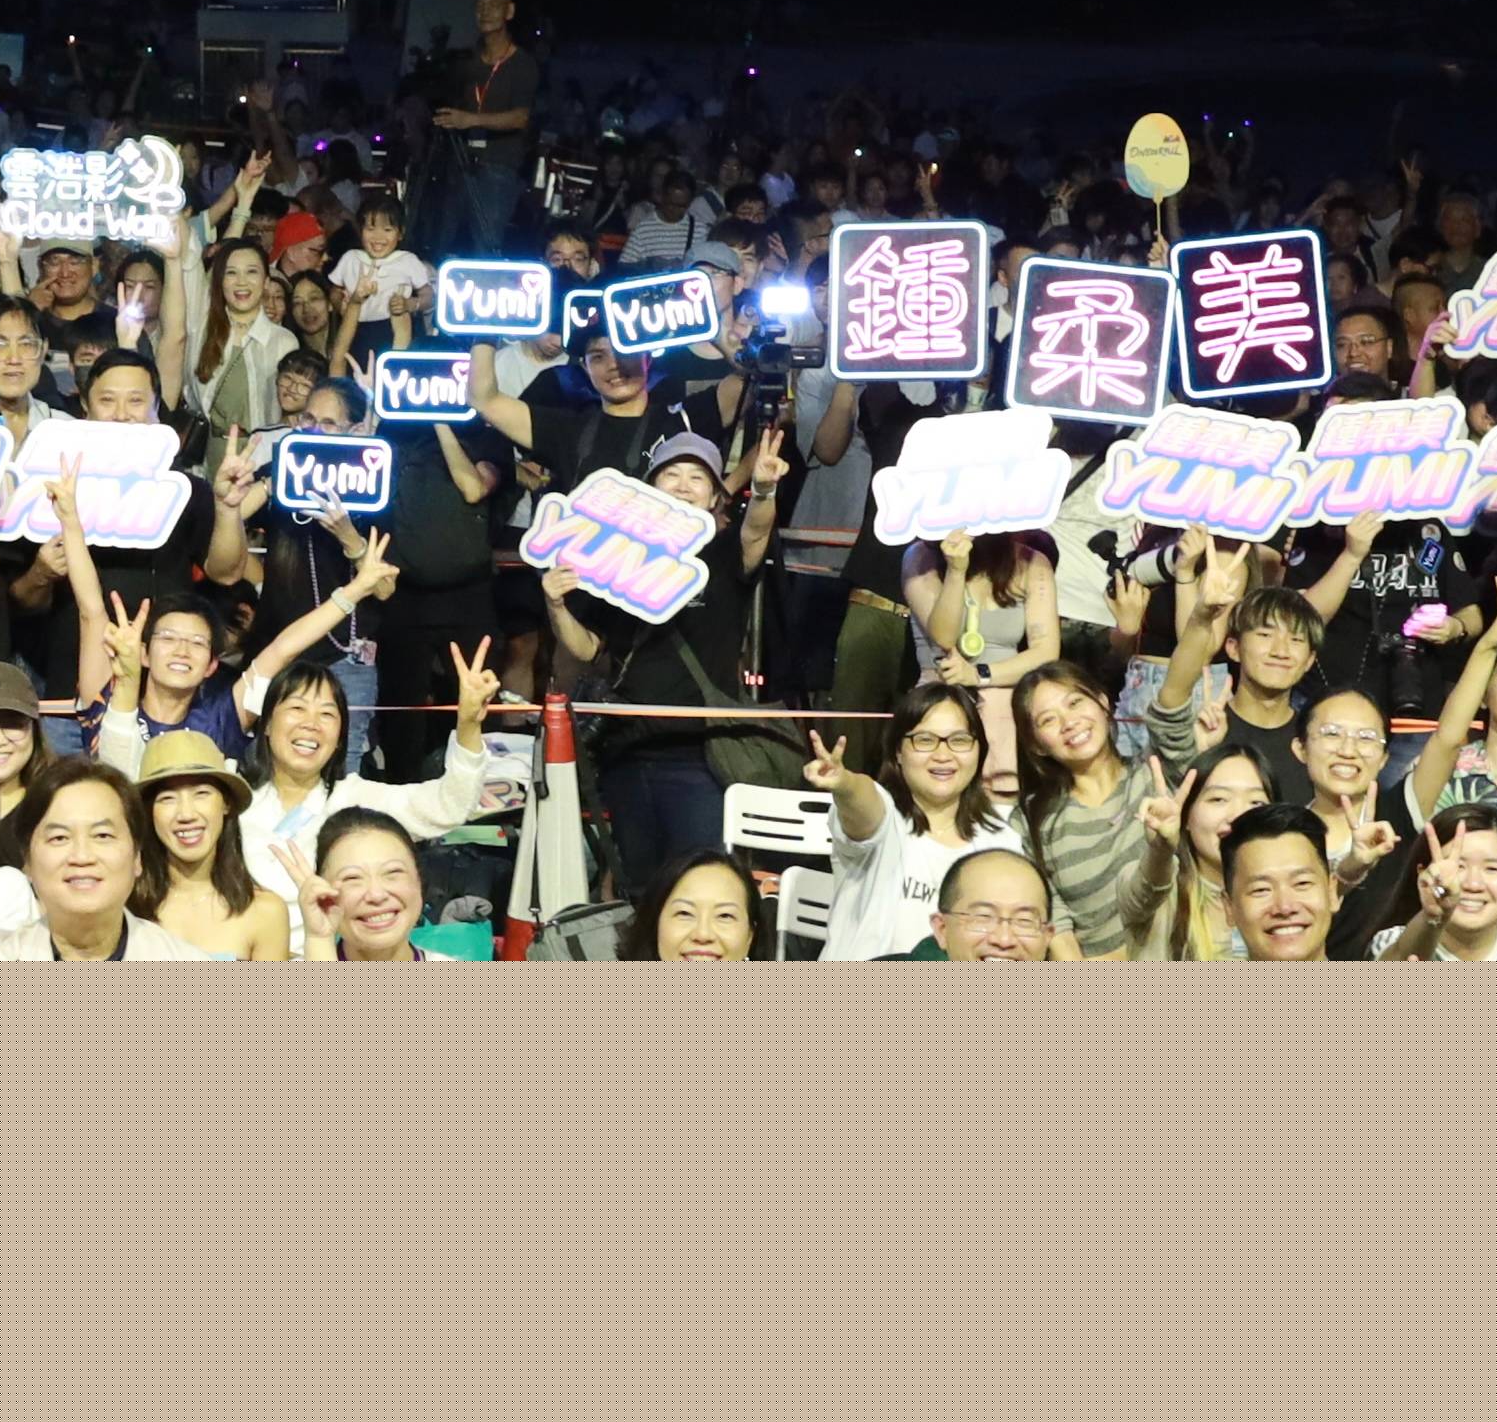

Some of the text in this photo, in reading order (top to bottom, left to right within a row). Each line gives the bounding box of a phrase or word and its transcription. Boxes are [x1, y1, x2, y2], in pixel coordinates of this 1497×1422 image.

[3, 152, 125, 201] 雲浩影
[2, 200, 170, 238] Cloud Wan
[445, 274, 544, 321] Yumi
[612, 280, 705, 340] Yumi
[844, 235, 969, 360] 鍾
[1192, 244, 1314, 382] 美
[1030, 279, 1149, 406] 柔
[382, 362, 470, 407] Yumi
[1143, 414, 1292, 471] 鍾柔美
[1315, 407, 1456, 456] 鍾柔美
[287, 448, 384, 495] Yumi
[1104, 450, 1296, 534] YUMI
[1291, 449, 1473, 516] YUMI
[527, 501, 700, 614] YUMI
